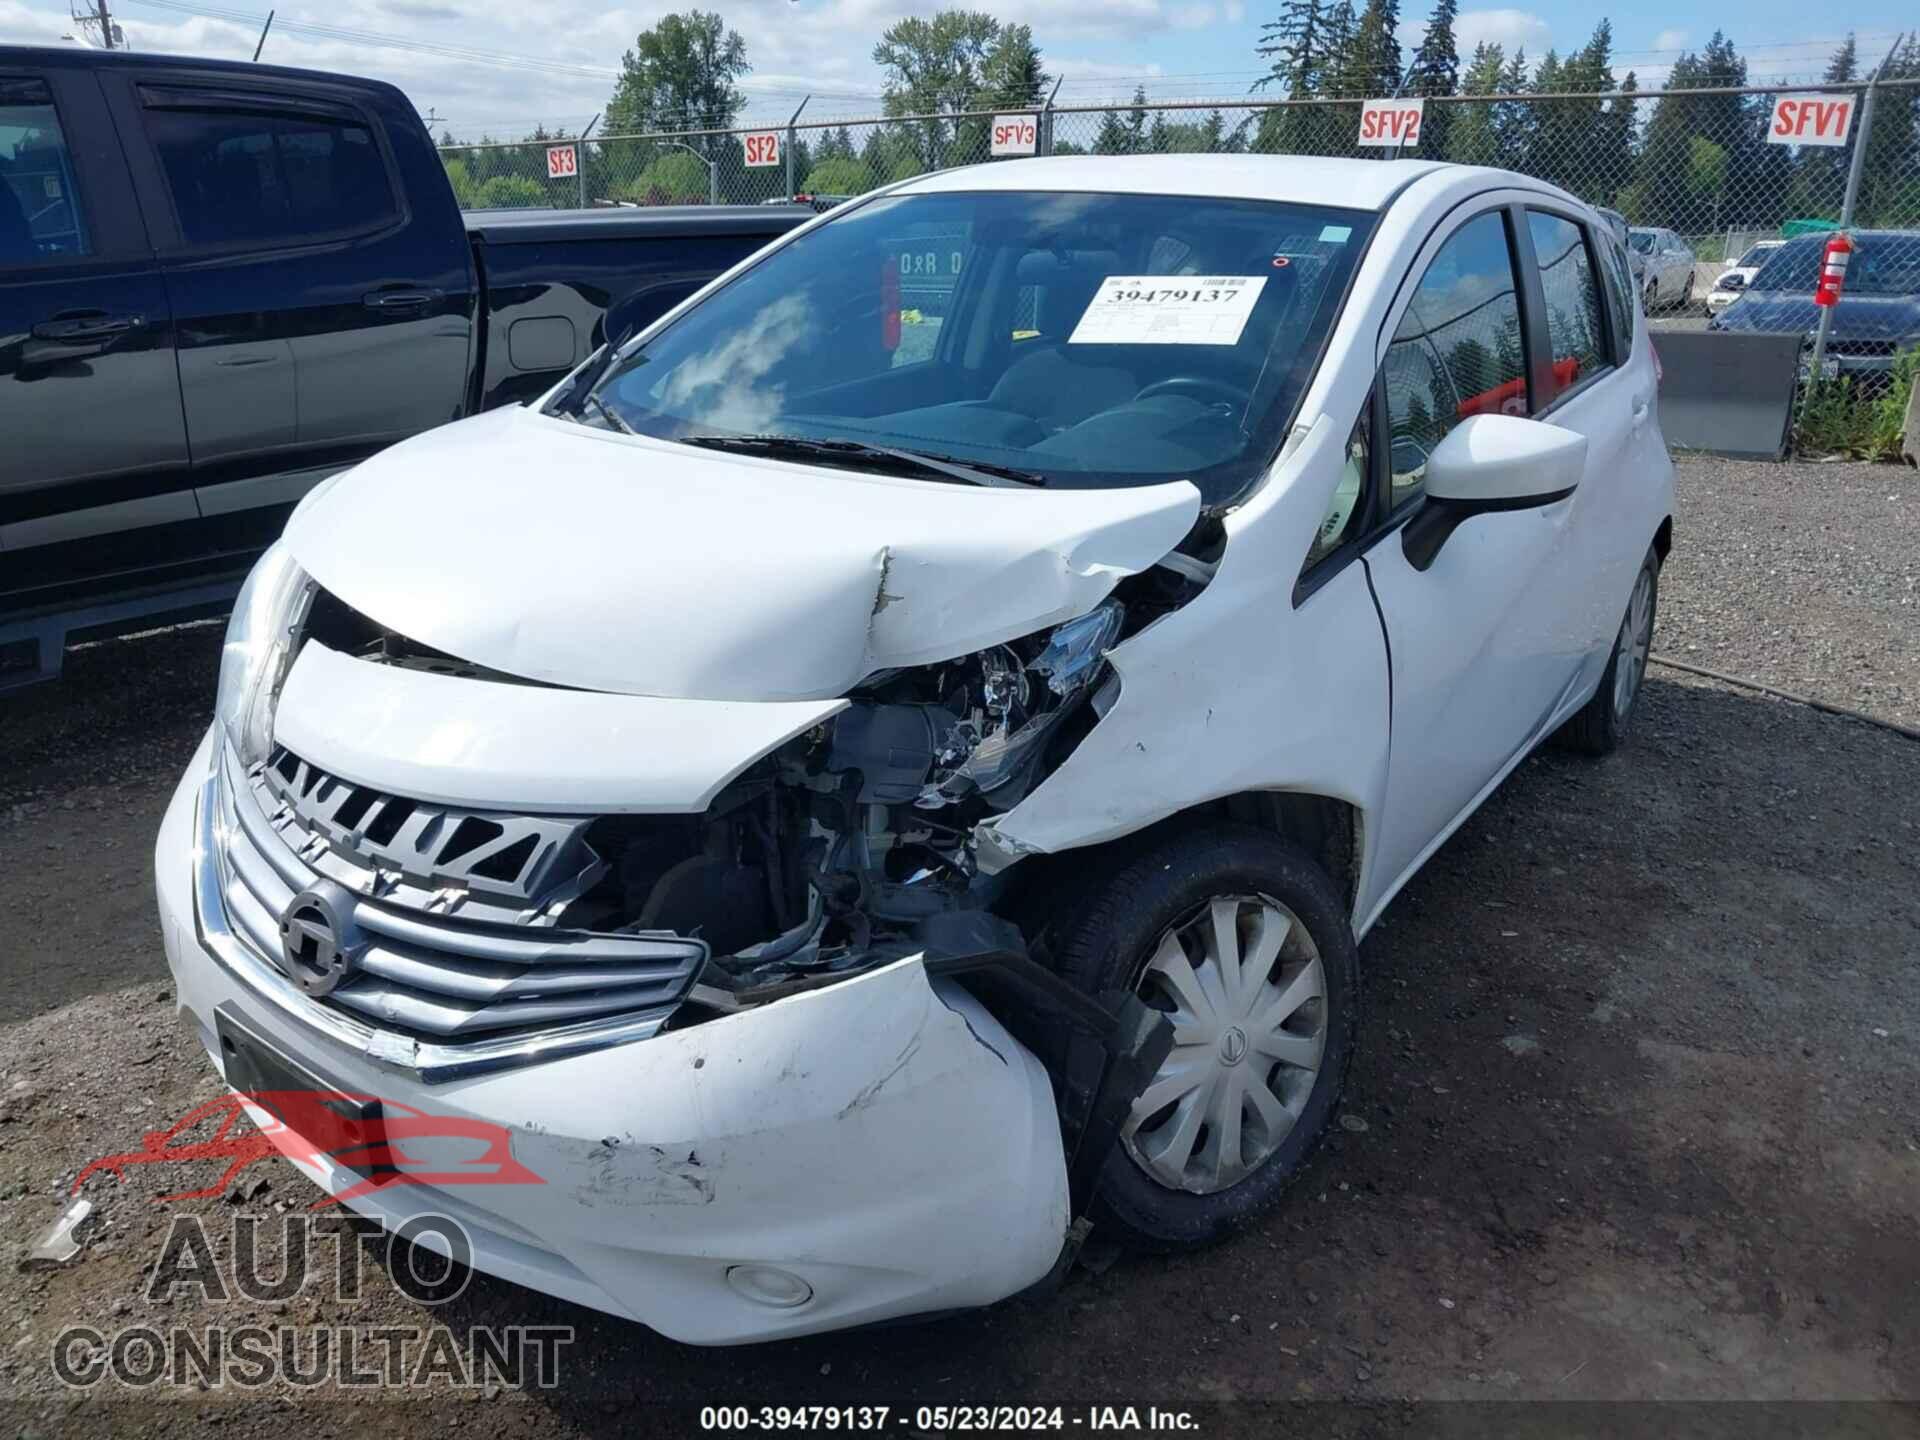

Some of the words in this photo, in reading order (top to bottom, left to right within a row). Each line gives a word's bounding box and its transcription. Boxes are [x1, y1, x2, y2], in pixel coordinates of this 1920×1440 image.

[1362, 110, 1420, 138] SFV2
[1775, 101, 1849, 136] SFV1
[995, 125, 1033, 145] SFV3
[550, 149, 574, 174] SF3
[747, 136, 776, 163] SF2
[1107, 289, 1239, 303] 39479137
